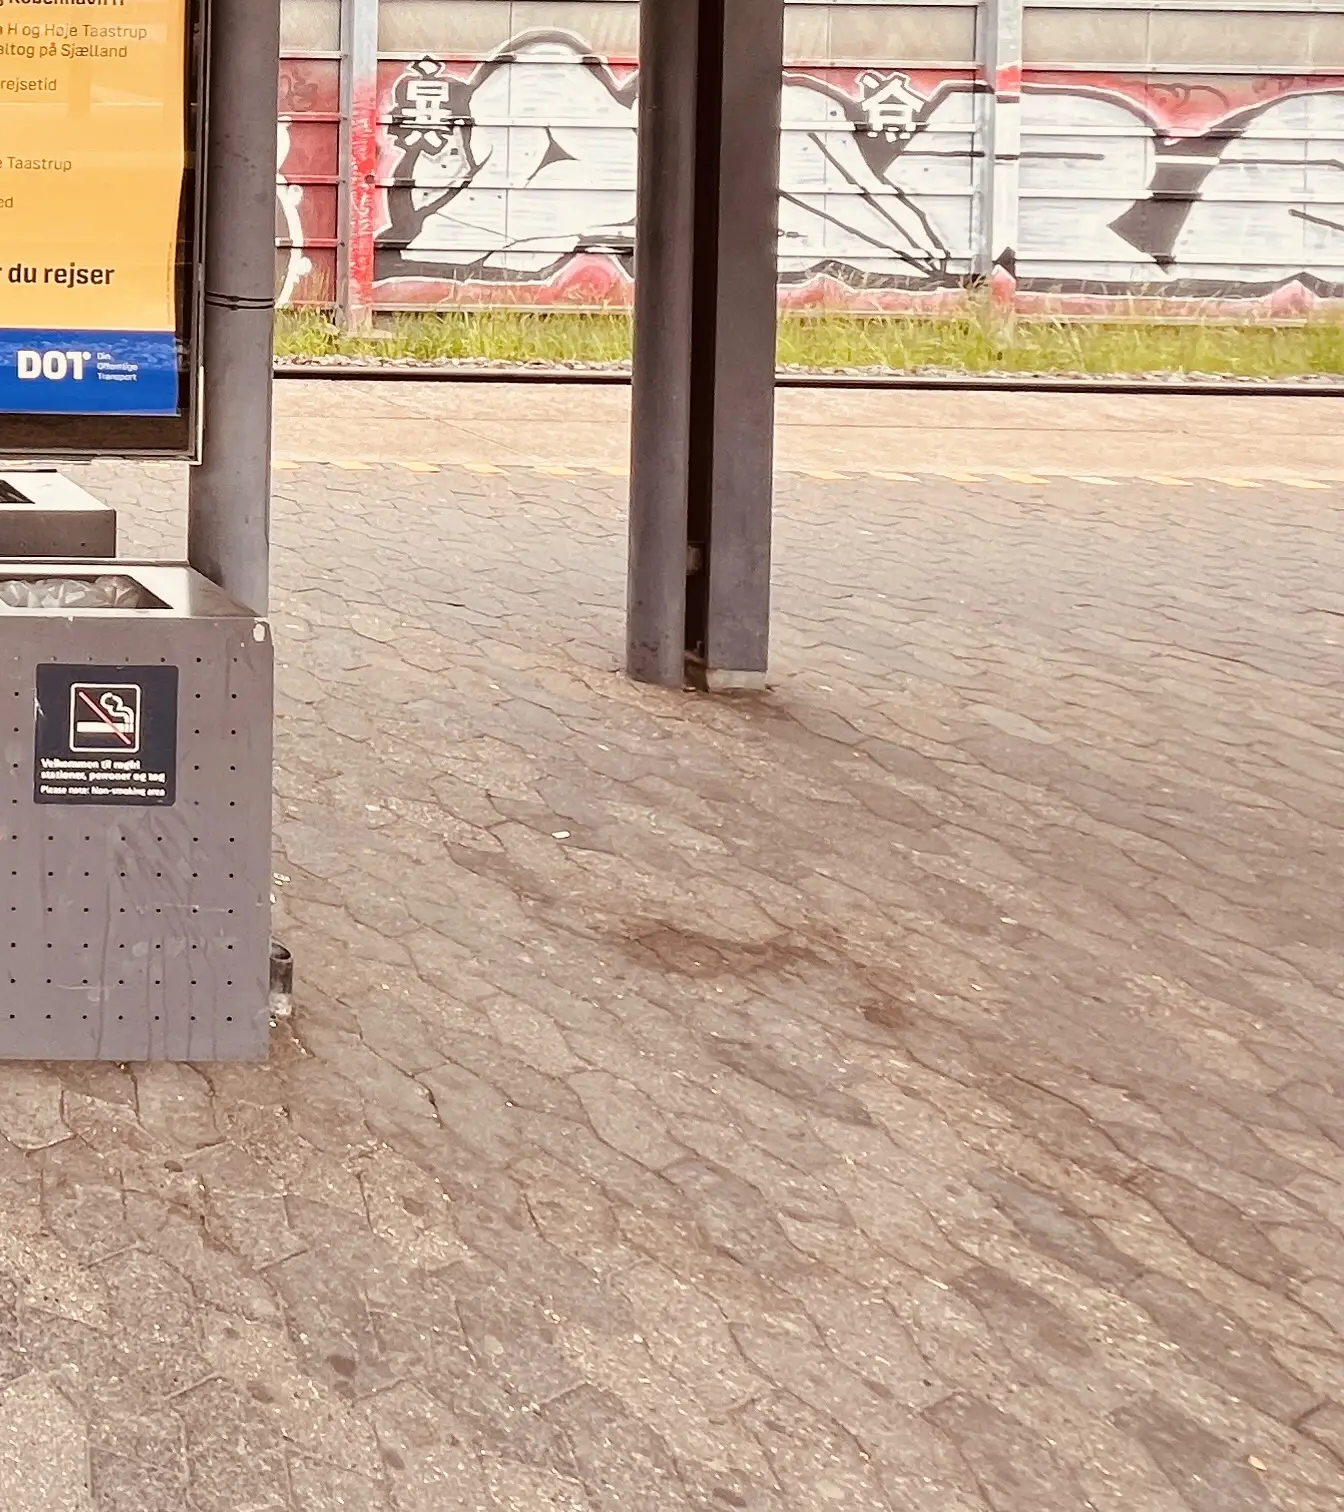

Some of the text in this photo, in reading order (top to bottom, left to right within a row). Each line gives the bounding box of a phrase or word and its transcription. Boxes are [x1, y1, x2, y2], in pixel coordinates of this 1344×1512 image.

[7, 23, 17, 35] H
[22, 25, 40, 38] og
[44, 24, 78, 39] Høje
[83, 24, 146, 40] Taastrup
[39, 42, 57, 58] på
[60, 42, 127, 59] Sjælland
[0, 77, 56, 93] rejsetid
[6, 156, 72, 172] Taastrup
[8, 263, 36, 283] du
[44, 261, 114, 289] rejser
[17, 350, 89, 380] DOT
